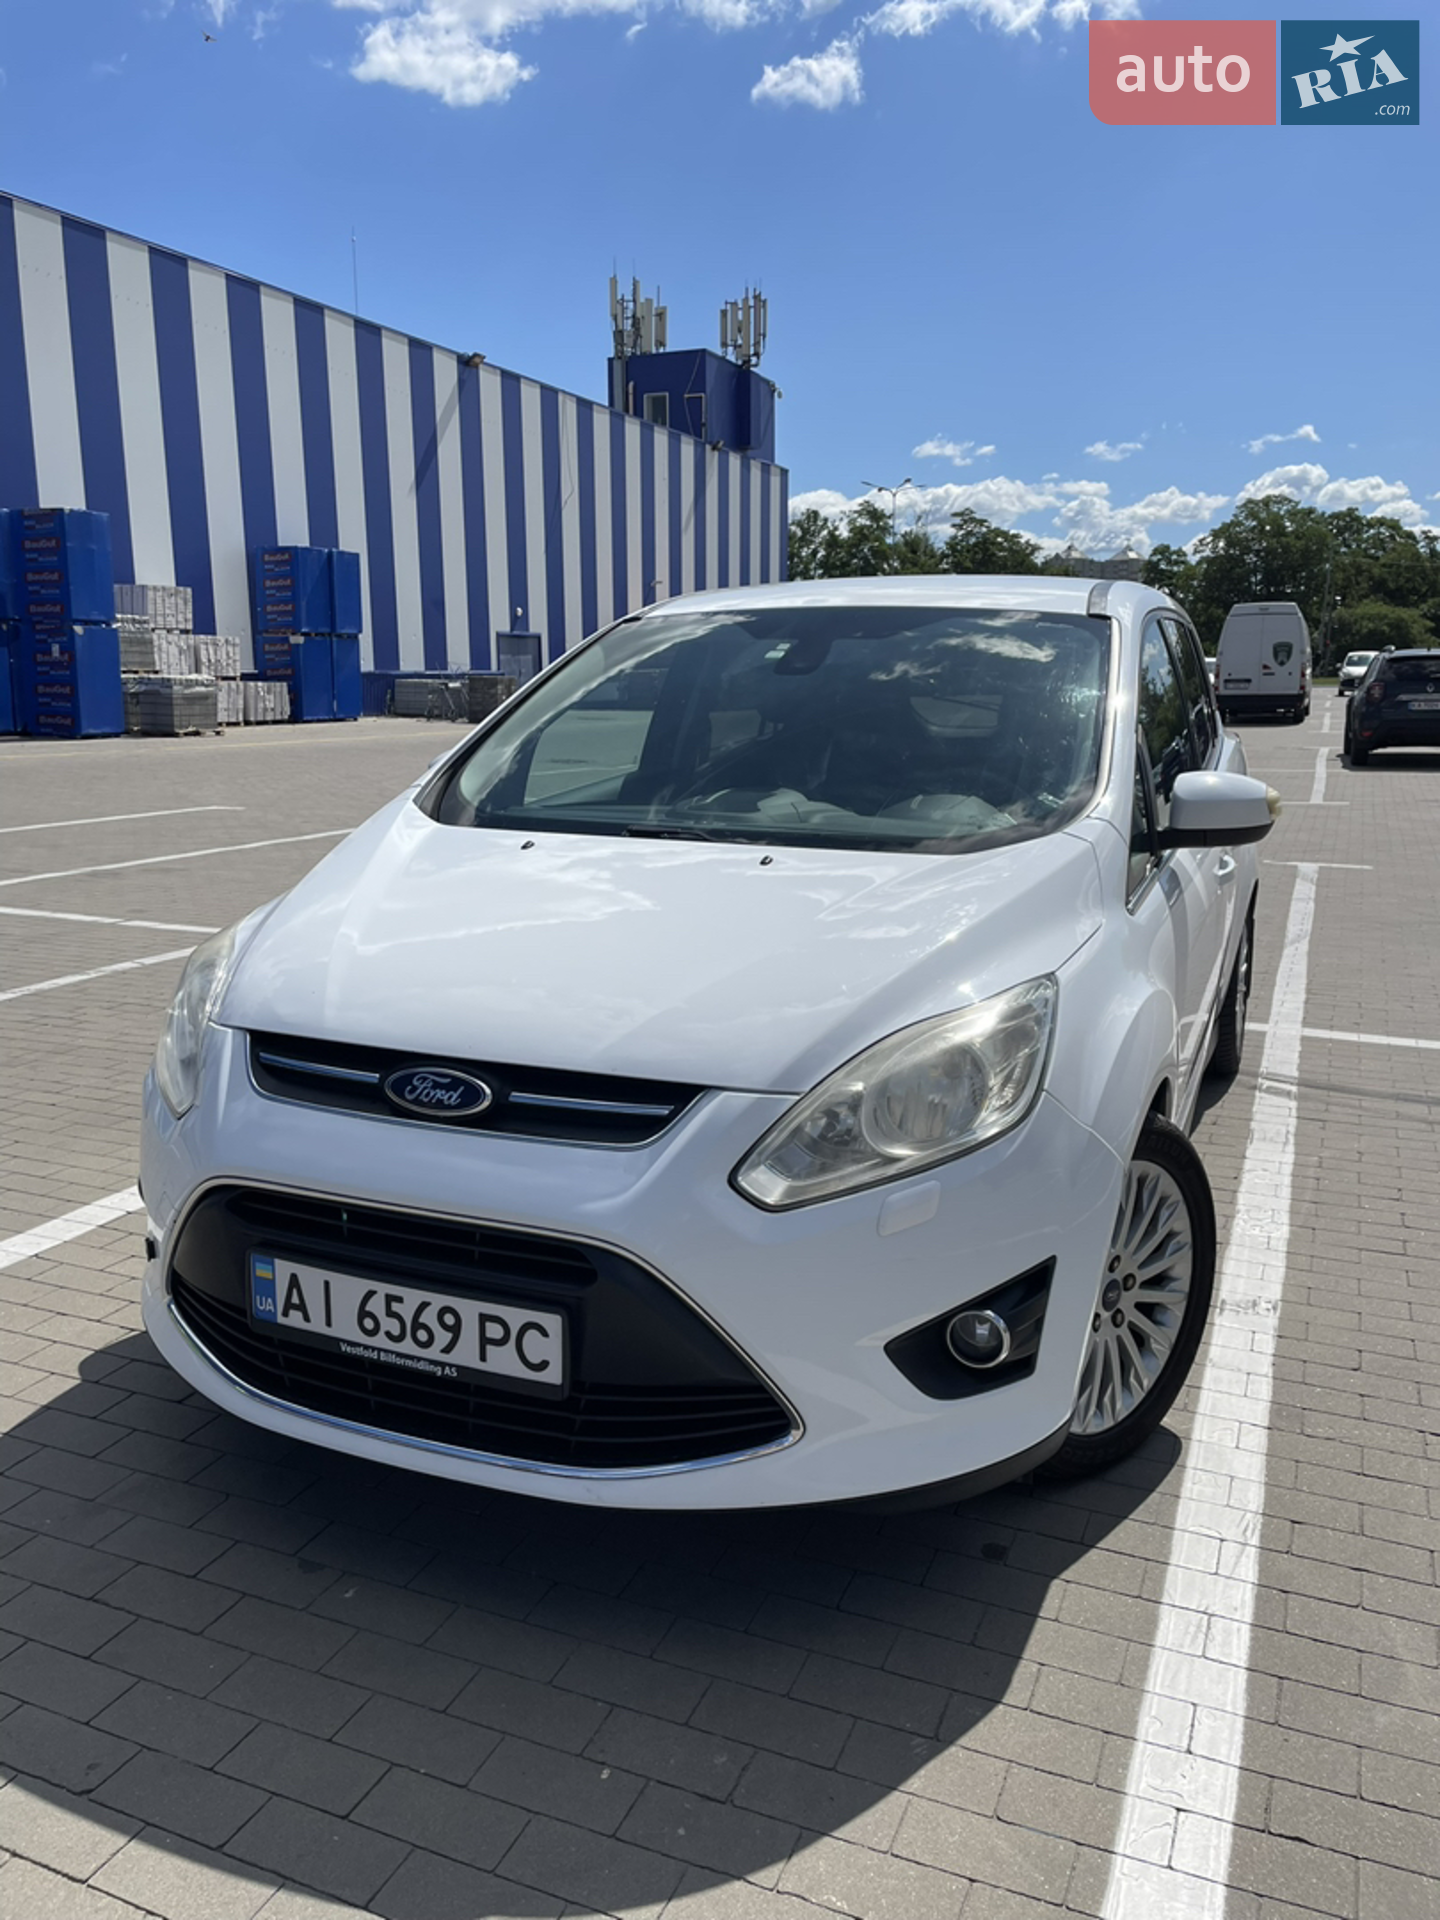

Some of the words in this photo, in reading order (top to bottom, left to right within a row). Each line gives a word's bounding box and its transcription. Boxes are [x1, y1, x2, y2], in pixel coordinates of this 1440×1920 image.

[404, 1073, 464, 1106] Ford
[255, 1295, 275, 1314] UA
[281, 1272, 333, 1328] AI
[356, 1289, 463, 1355] 6569
[478, 1312, 551, 1373] PC
[339, 1341, 378, 1359] Vestfold
[380, 1351, 442, 1377] Bilformidling
[443, 1365, 458, 1377] AS
